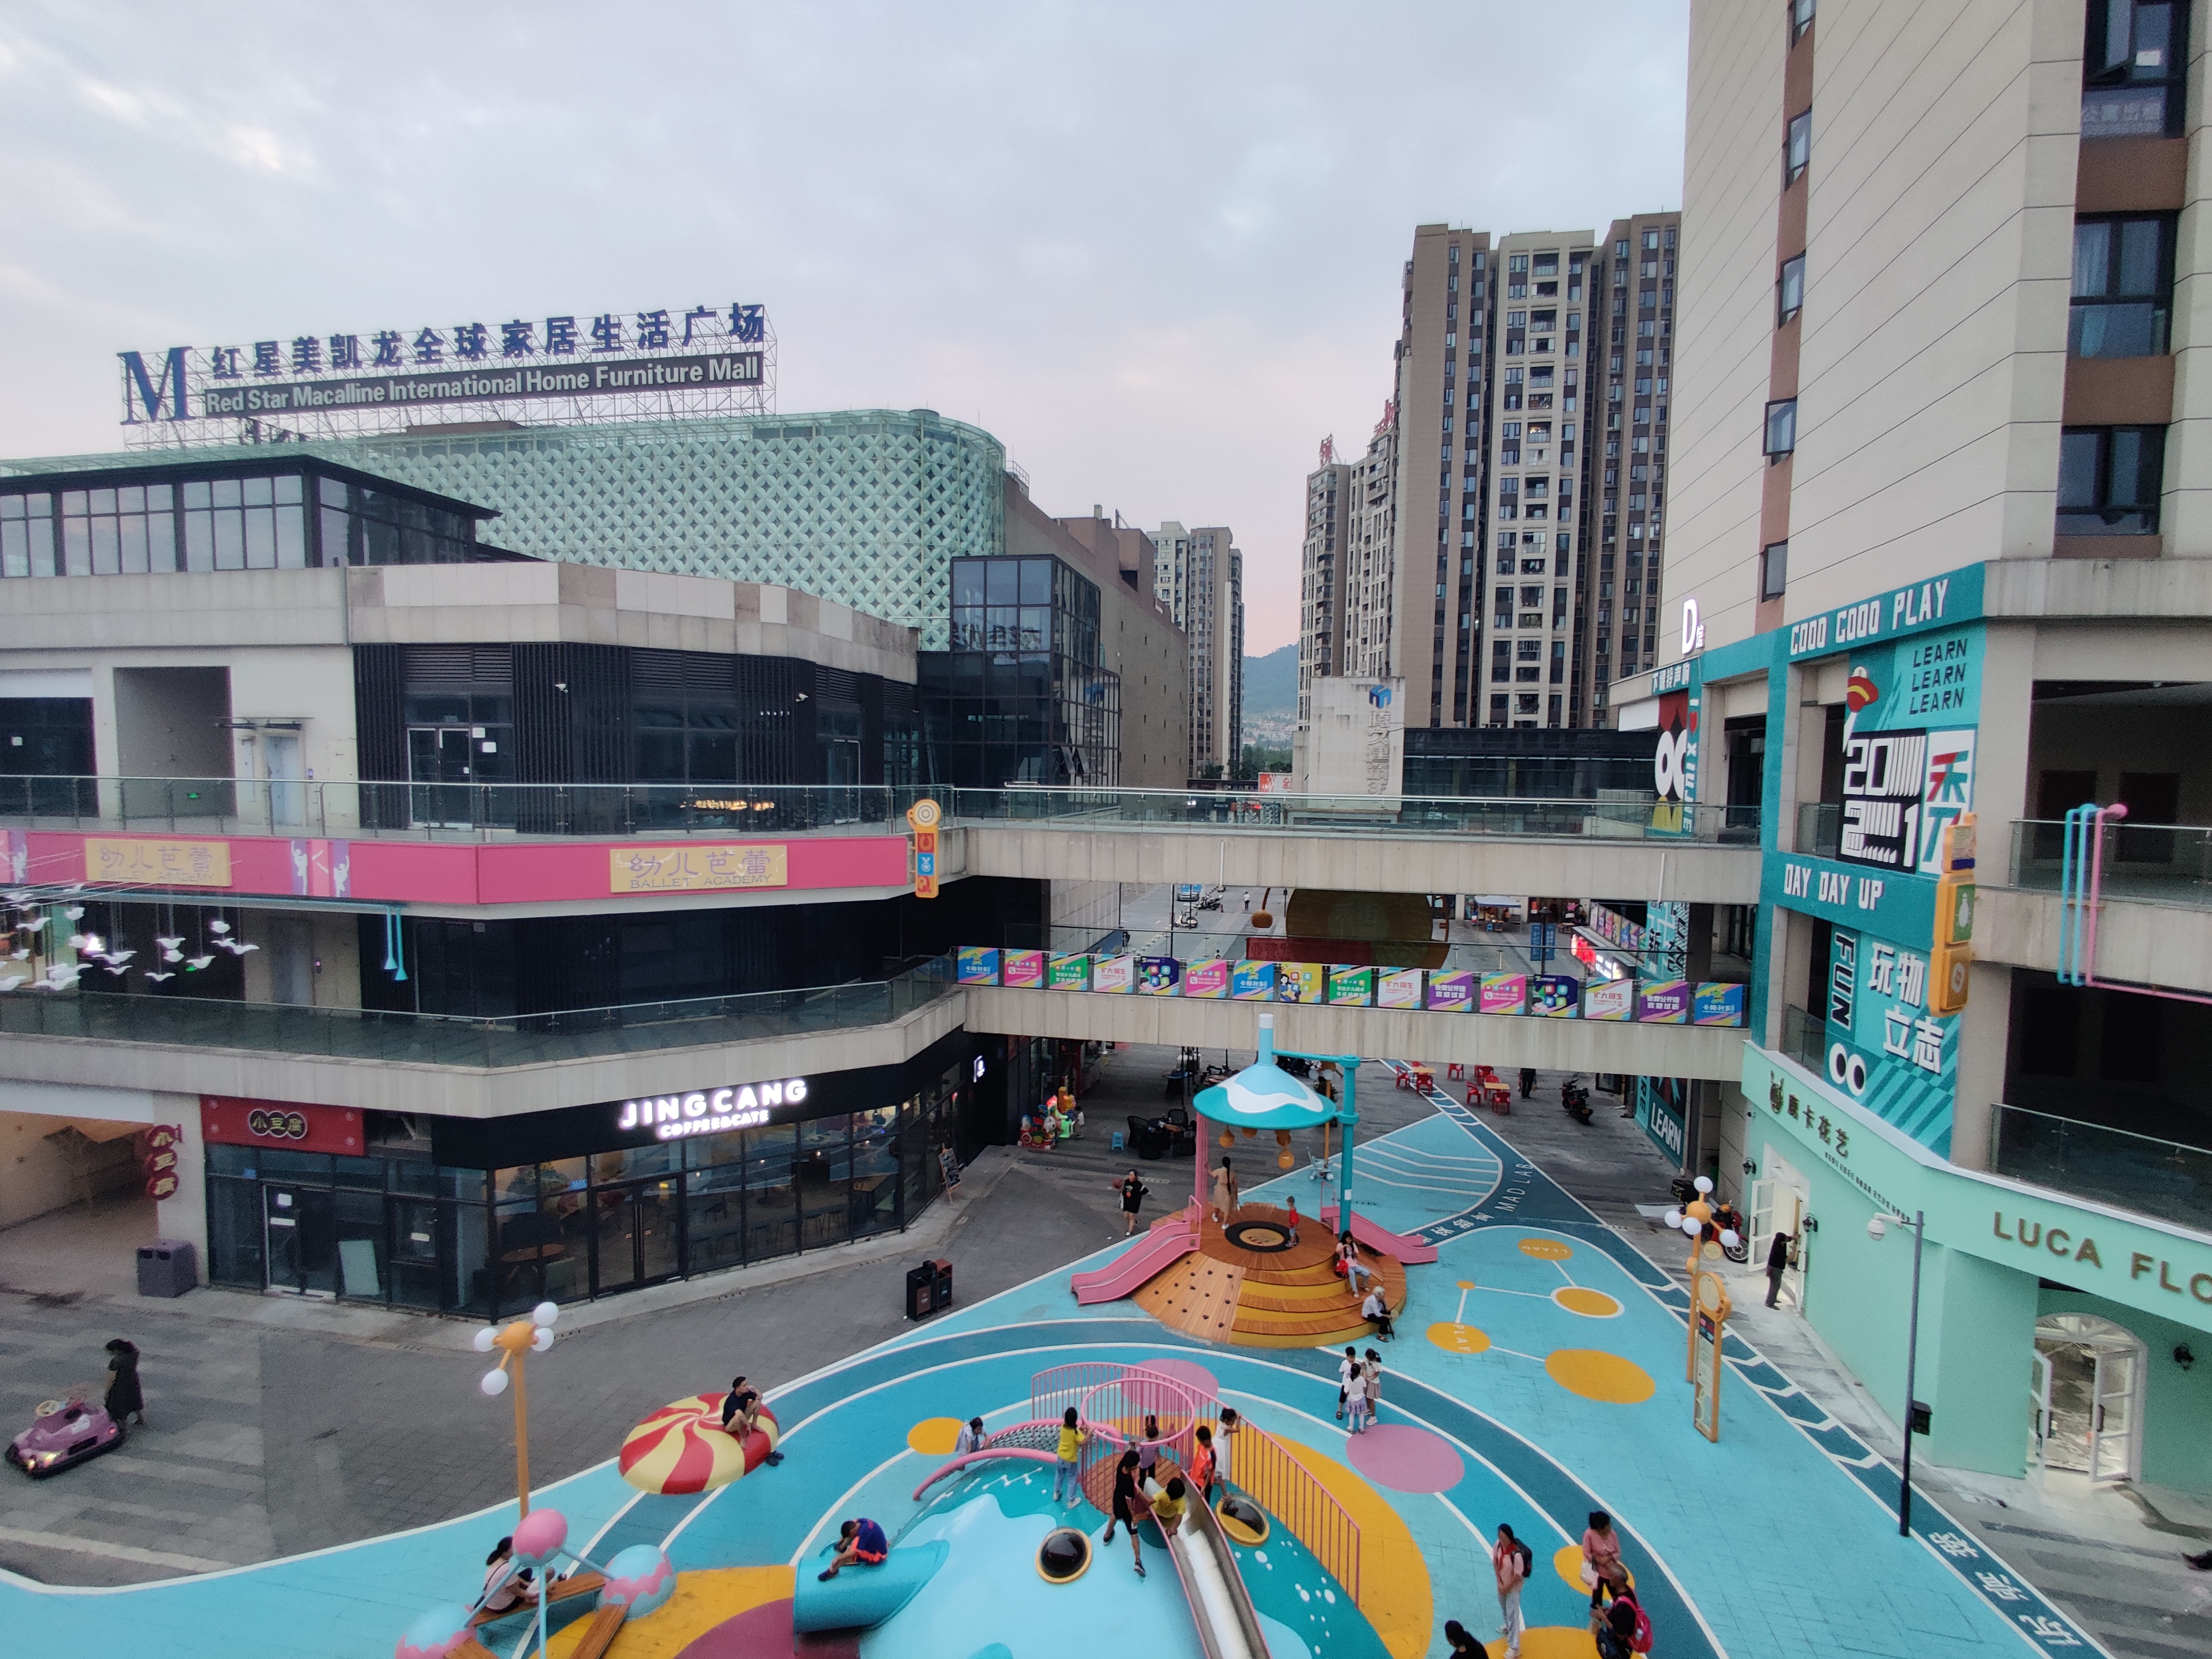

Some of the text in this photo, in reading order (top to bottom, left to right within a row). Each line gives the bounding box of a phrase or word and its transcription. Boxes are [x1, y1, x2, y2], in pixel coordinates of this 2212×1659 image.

[212, 302, 764, 380] 红星美凯龙全球家居生活广场
[207, 356, 758, 413] Red Star Macalline International Home Furniture Mall
[1892, 578, 1948, 630] PLAY
[1913, 638, 1967, 668] LEARN
[1911, 663, 1966, 692] LEARN
[1909, 687, 1964, 715] LEARN
[100, 844, 212, 872] 幼儿芭蕾
[630, 849, 771, 878] 幼儿芭蕾
[630, 874, 771, 889] BALLET ACADEMY
[1783, 864, 1884, 910] DAY DAY UP
[1830, 931, 1856, 1031] FUN
[1868, 942, 1925, 1007] 玩物
[1883, 1005, 1945, 1075] 立志
[251, 1115, 303, 1133] 小豆腐
[1651, 1102, 1682, 1155] LEARN
[1494, 1163, 1534, 1212] MAD LAB
[1522, 1245, 1568, 1253] LEARN
[1994, 1211, 2103, 1269] LUCA
[1453, 1324, 1471, 1352] PLAY
